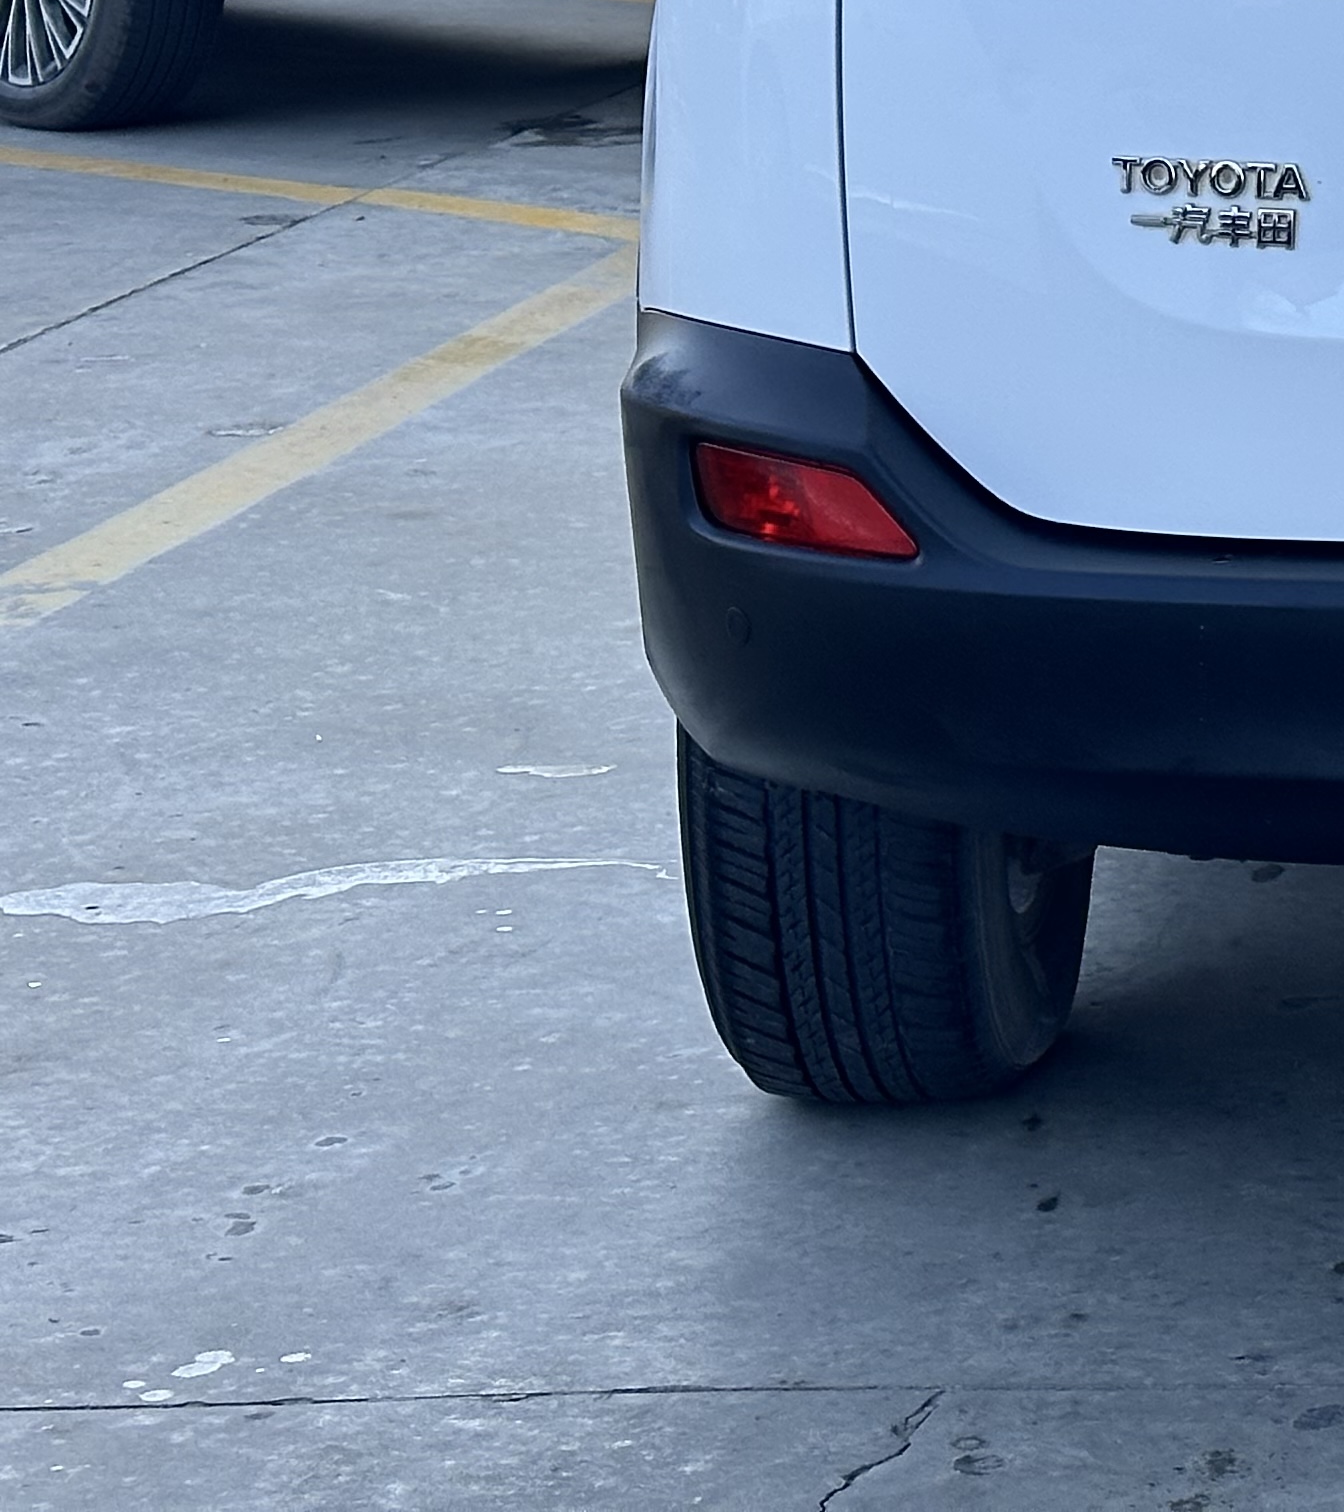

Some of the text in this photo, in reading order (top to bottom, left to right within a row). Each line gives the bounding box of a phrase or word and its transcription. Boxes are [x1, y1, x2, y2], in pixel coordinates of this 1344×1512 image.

[1111, 156, 1311, 201] TOYOTA
[1130, 202, 1297, 251] 一汽丰田
